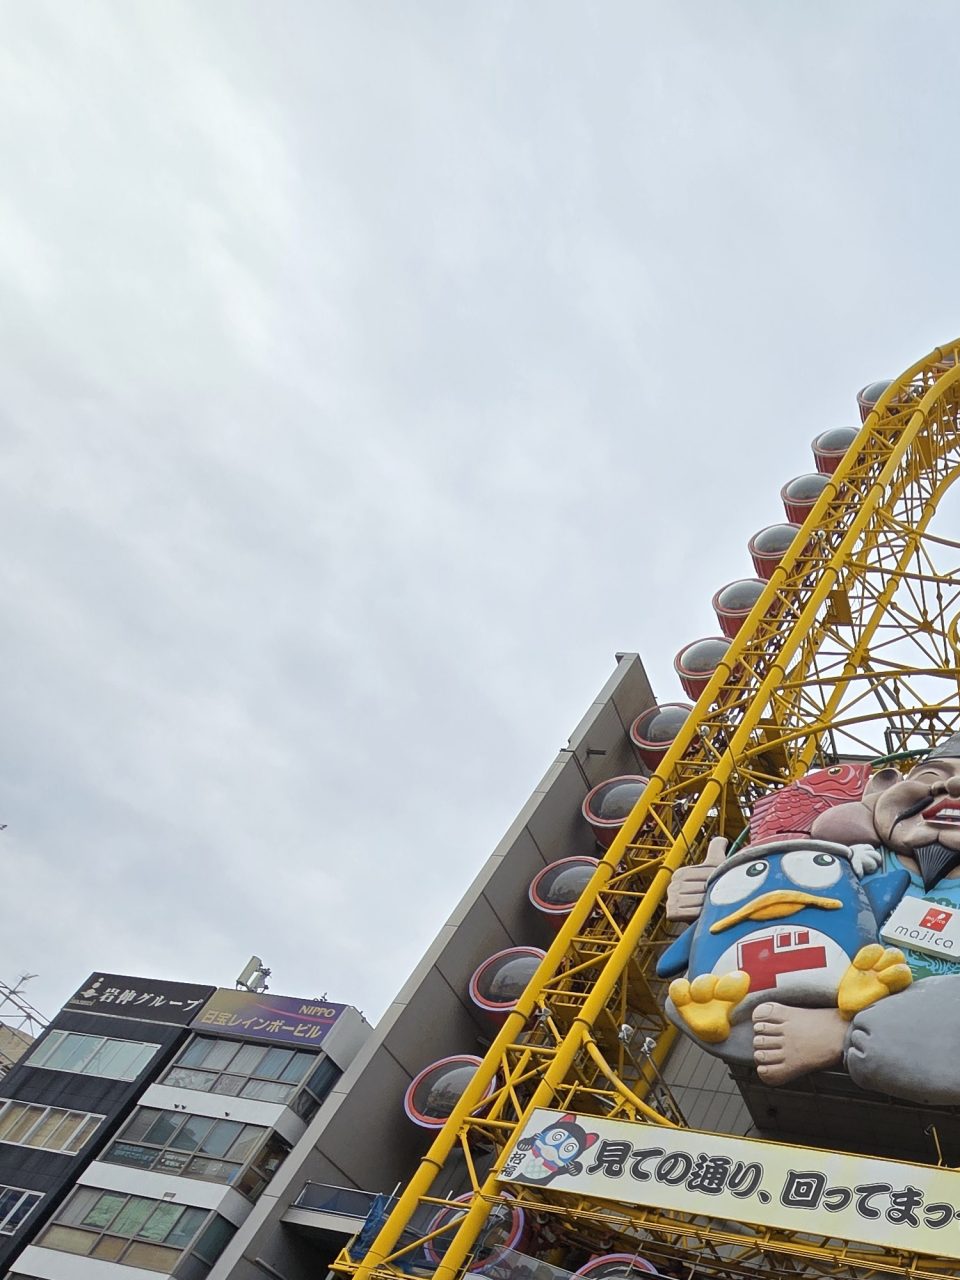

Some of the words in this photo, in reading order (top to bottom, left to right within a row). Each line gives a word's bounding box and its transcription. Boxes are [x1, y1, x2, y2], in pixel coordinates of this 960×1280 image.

[299, 1003, 336, 1018] NIPPO
[201, 1009, 322, 1040] 日宝レインボービル
